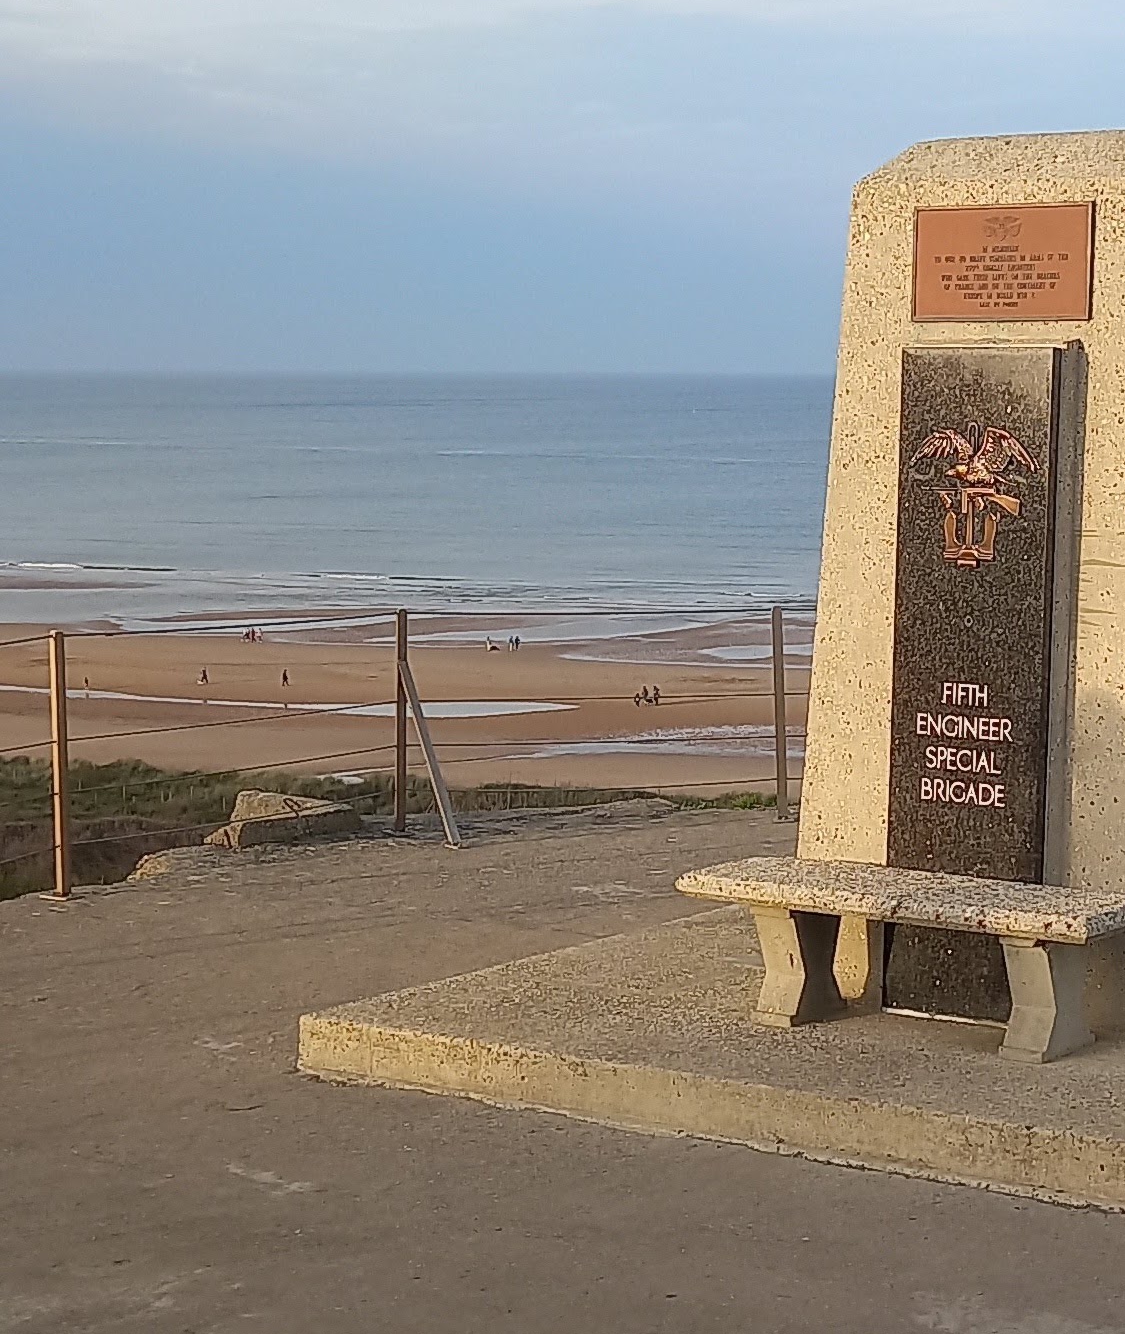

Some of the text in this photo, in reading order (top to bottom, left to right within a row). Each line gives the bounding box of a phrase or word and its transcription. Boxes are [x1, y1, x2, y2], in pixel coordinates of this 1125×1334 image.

[941, 682, 988, 707] FIFTH
[916, 712, 1013, 742] ENGINEER
[925, 746, 1001, 775] SPECIAL
[920, 777, 1005, 807] BRIGADE
